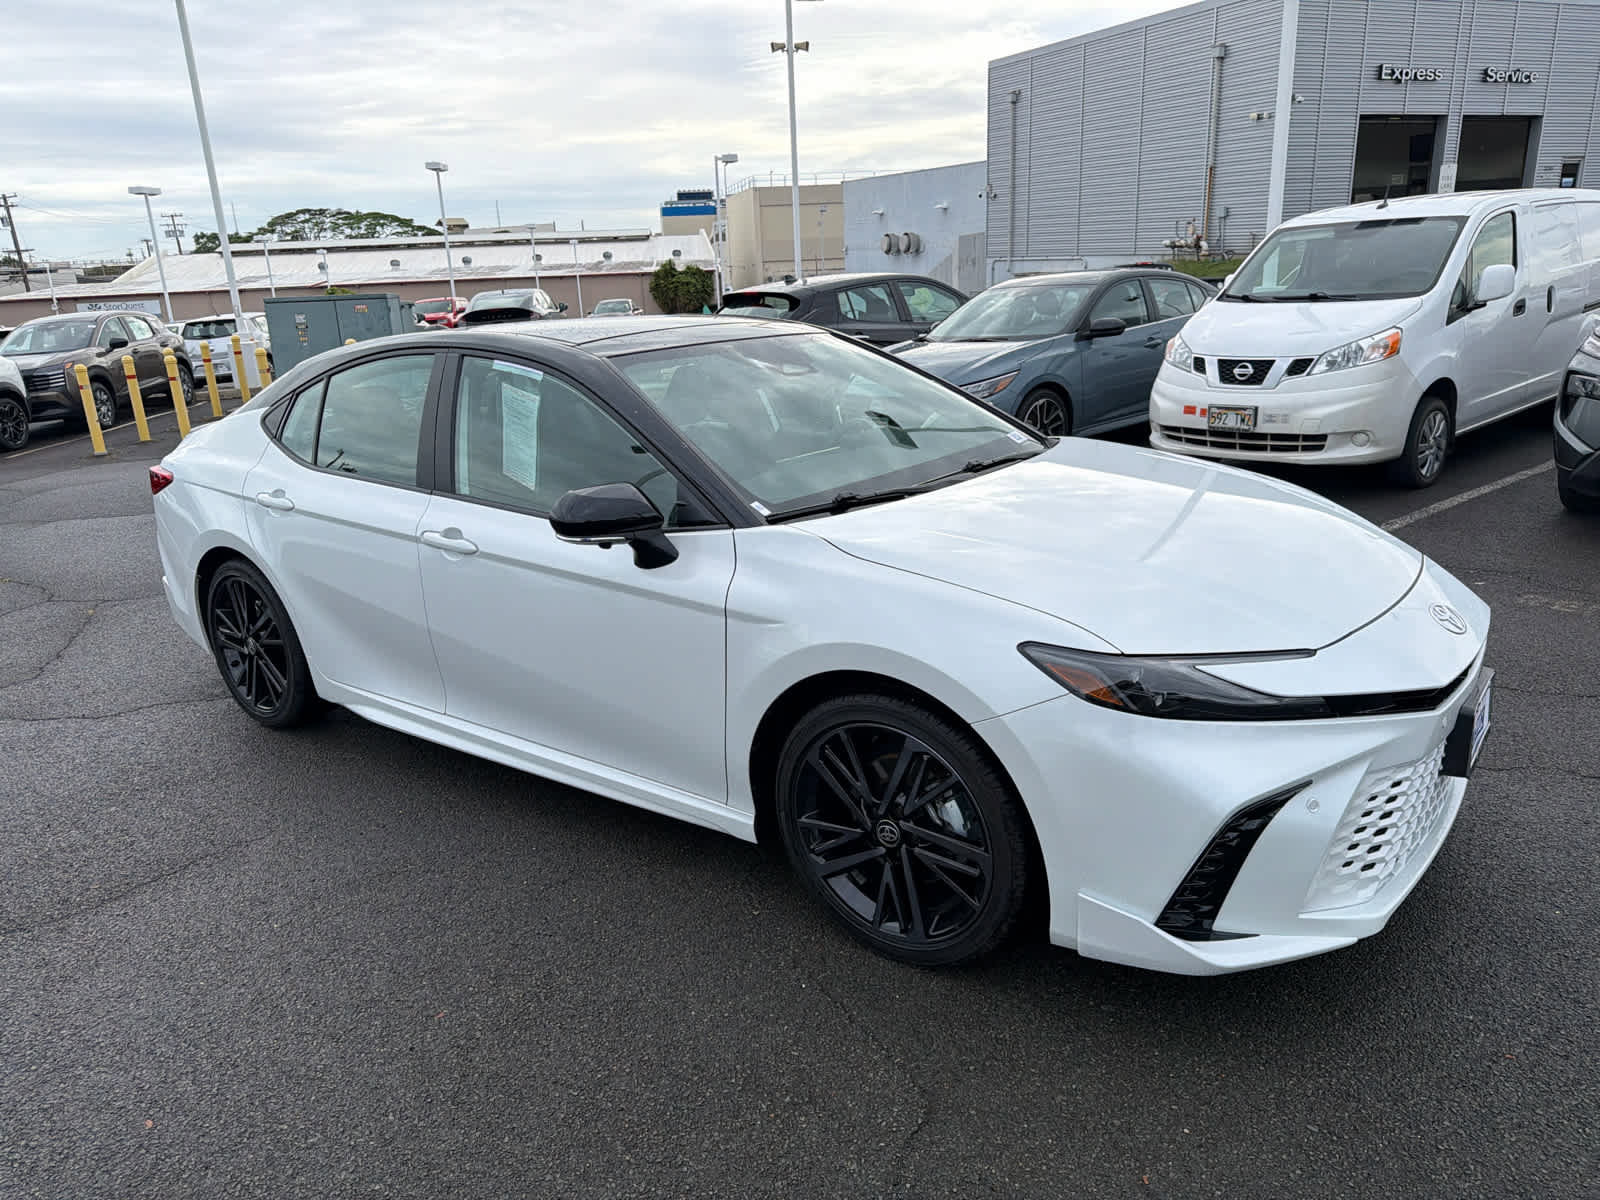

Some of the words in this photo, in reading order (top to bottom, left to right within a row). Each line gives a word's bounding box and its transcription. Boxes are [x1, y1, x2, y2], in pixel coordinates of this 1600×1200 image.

[1380, 63, 1444, 84] Express
[1485, 66, 1540, 84] Service
[1209, 411, 1229, 425] 592
